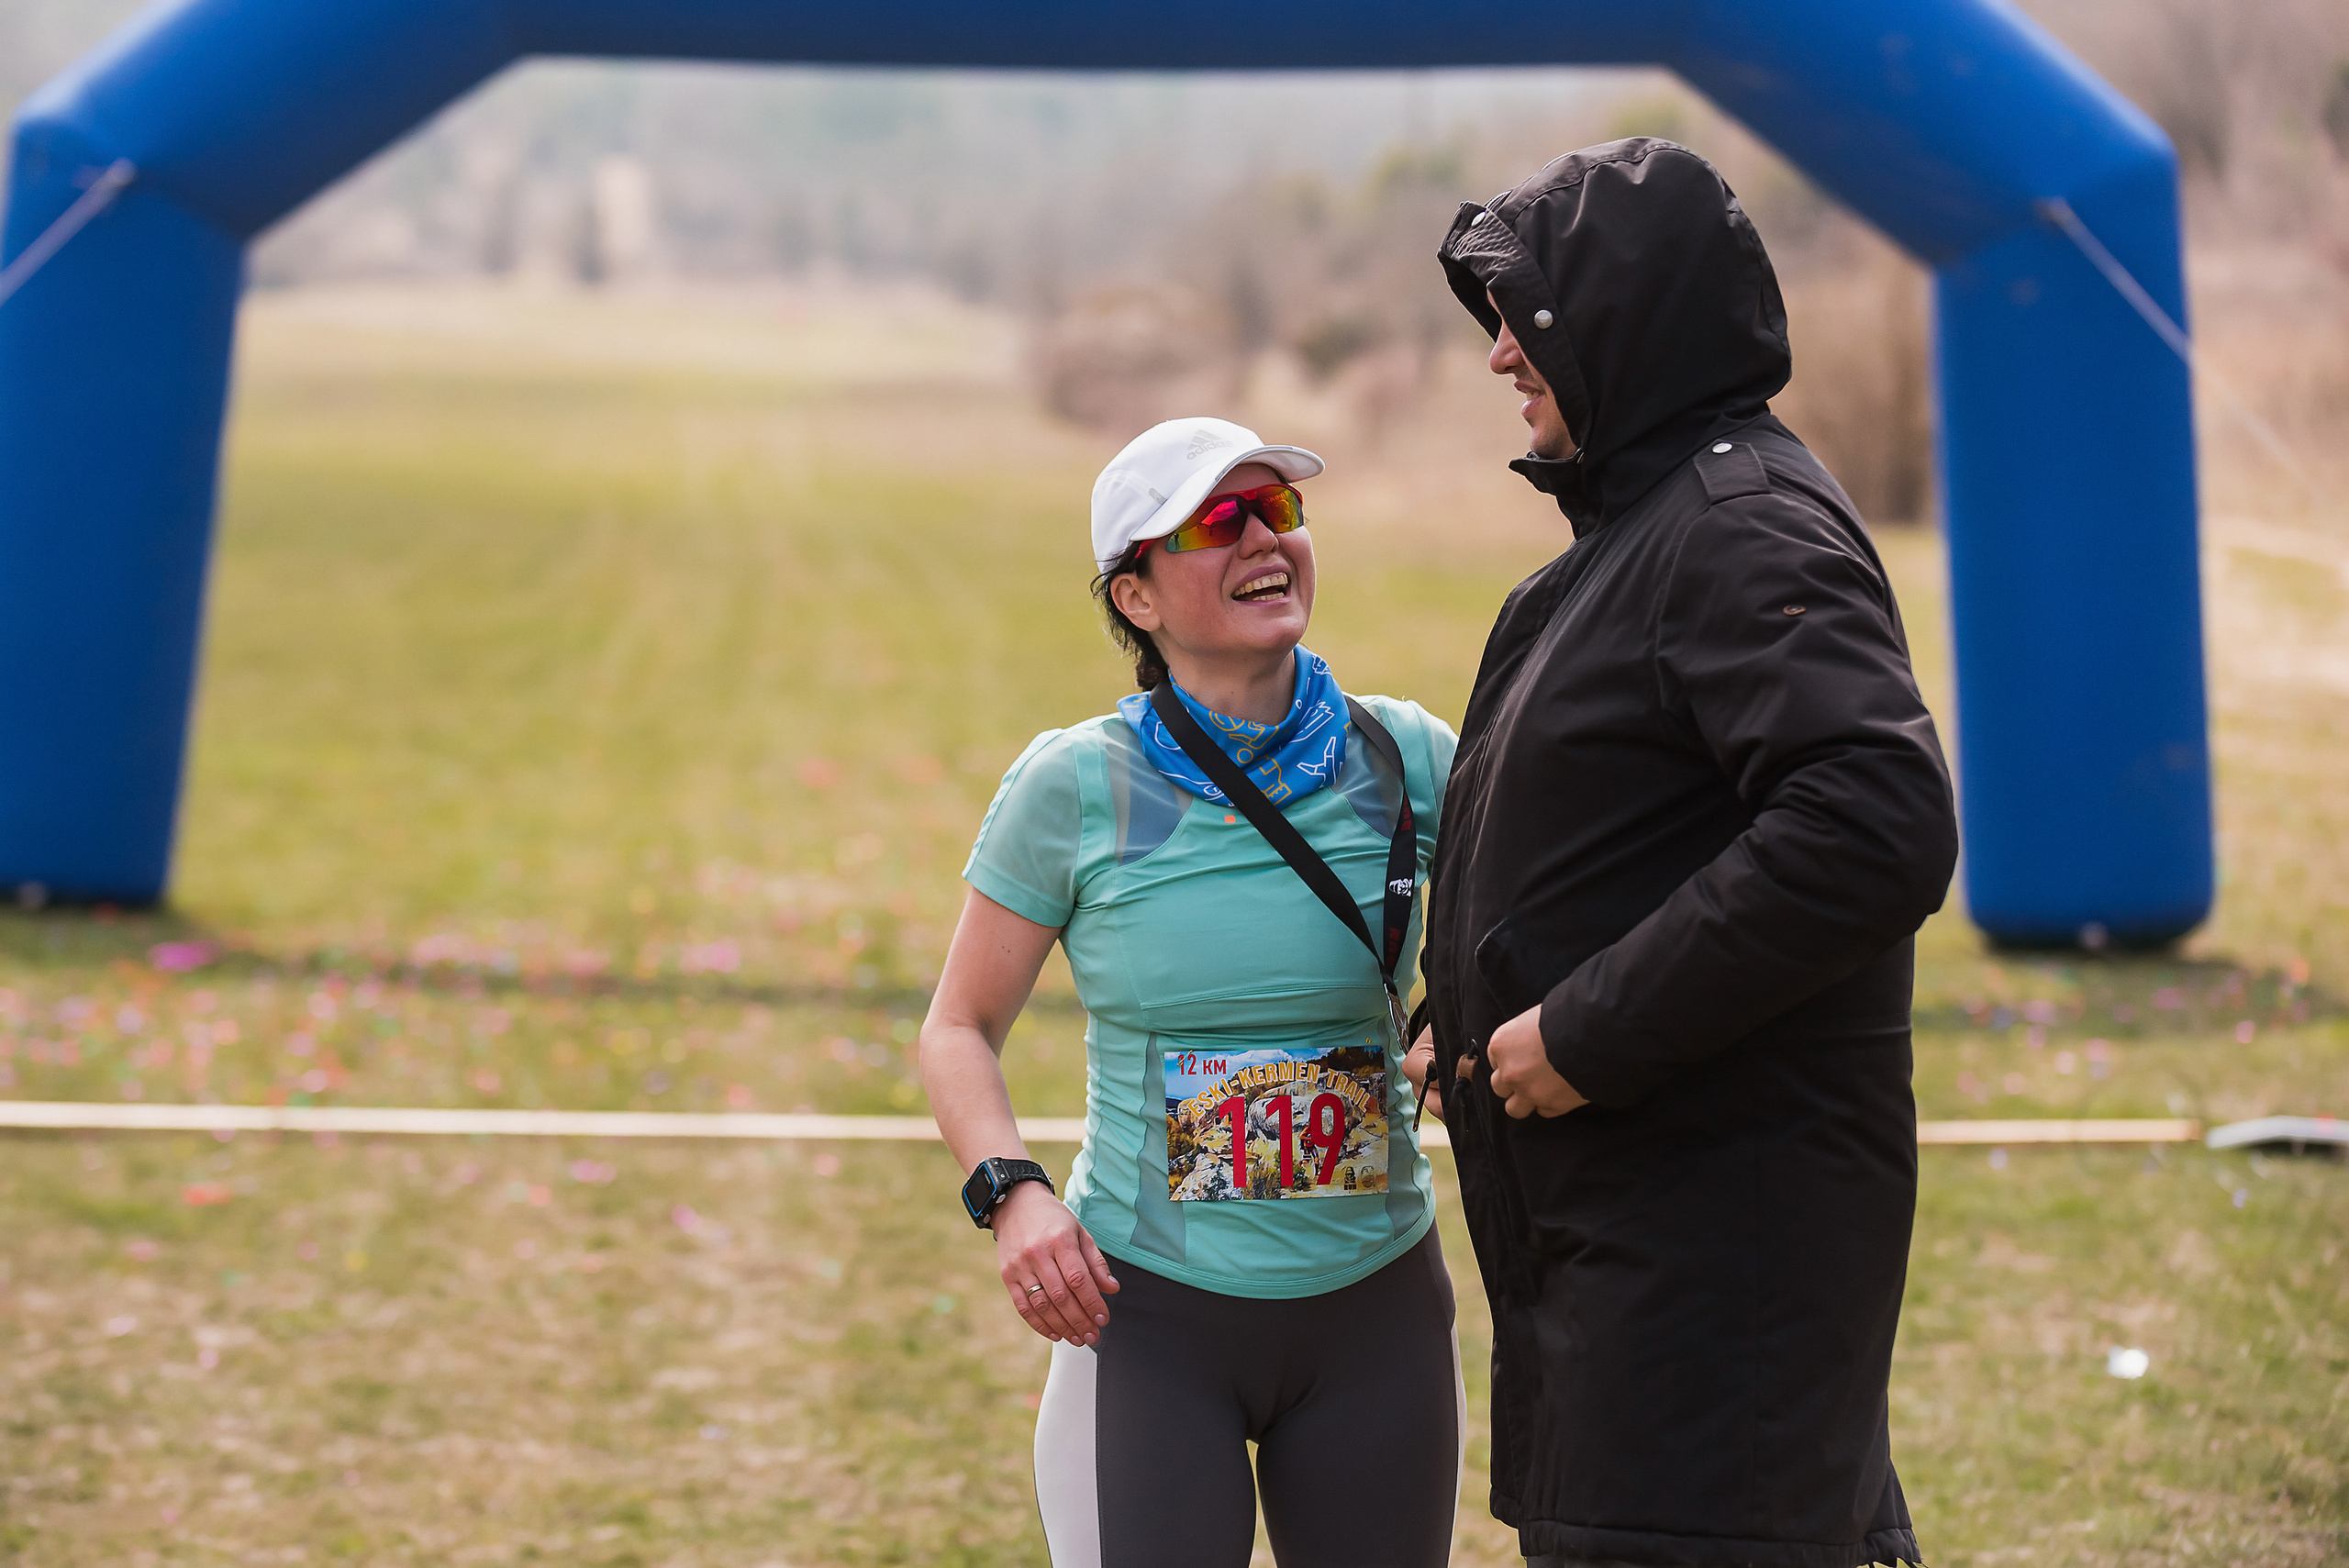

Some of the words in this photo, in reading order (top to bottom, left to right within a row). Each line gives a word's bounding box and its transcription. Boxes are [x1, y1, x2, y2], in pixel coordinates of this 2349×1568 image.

[1186, 440, 1233, 460] adidas
[1178, 1054, 1197, 1075] 12
[1187, 1062, 1321, 1118] ESKI-KERMEN
[1327, 1068, 1372, 1113] TRAIL
[1219, 1093, 1345, 1188] 119
